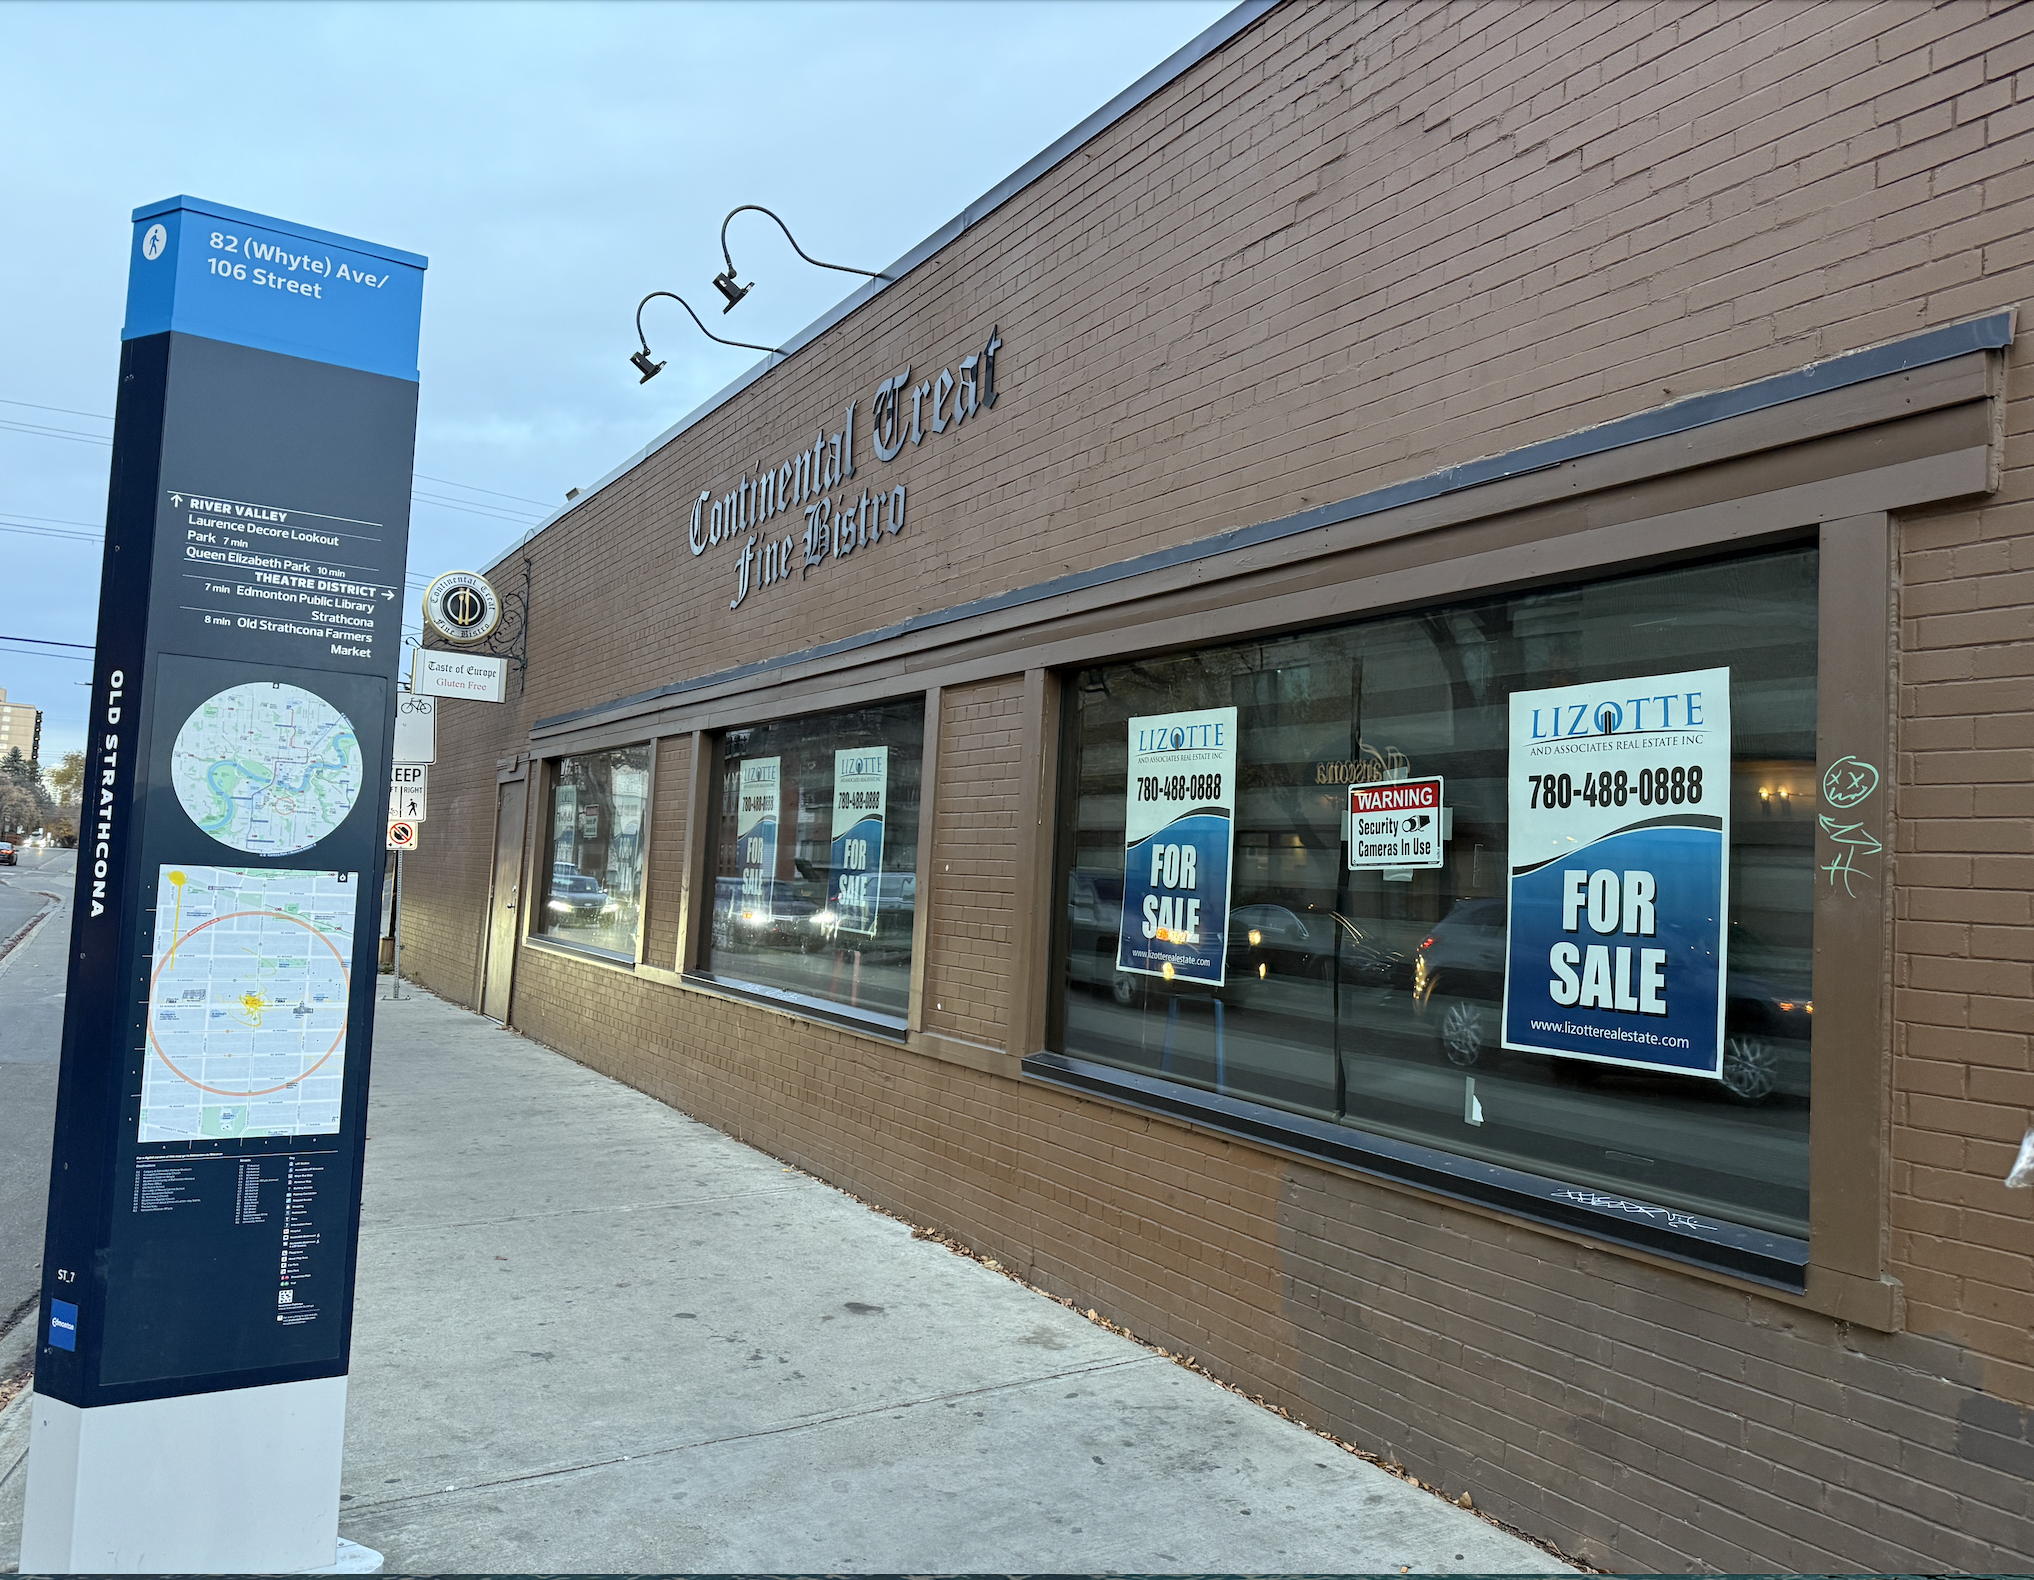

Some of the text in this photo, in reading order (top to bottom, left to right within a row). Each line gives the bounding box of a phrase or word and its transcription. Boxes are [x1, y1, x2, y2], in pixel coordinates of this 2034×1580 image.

[209, 231, 389, 289] 82 (Whyte) Ave/
[207, 257, 322, 298] 106 Street
[689, 324, 1003, 556] Continental Treat
[190, 498, 288, 523] RIVER VALLEY
[187, 530, 249, 548] Park 7 min
[188, 514, 339, 546] Laurence Decore Lookout
[802, 484, 906, 581] Bistro
[186, 547, 345, 578] Queen Elizabeth Park 10 min
[205, 583, 374, 614] 7 min Edmonton Public Library
[255, 572, 377, 597] THEATRE DISTRICT
[430, 577, 477, 603] Continental
[204, 615, 373, 643] 8 min Old Strathcona Farmers
[311, 611, 374, 627] Strathcona
[331, 644, 371, 658] Market
[428, 661, 496, 678] Taste of Europe
[436, 678, 486, 691] Gluten Free
[1530, 692, 1704, 739] LIZOTTE
[1139, 723, 1224, 751] LIZOTTE
[1530, 734, 1704, 756] AND ASSOCIATES REAL ESTATE INC
[842, 757, 881, 774] LIZOTTE
[90, 670, 124, 918] OLD STRATHCONA
[1137, 773, 1221, 801] 780-488-0888
[1358, 787, 1433, 810] WARNING
[1528, 766, 1703, 809] 780-488-0888
[1359, 817, 1398, 837] Security
[747, 837, 763, 864] FOR
[844, 839, 867, 870] FOR
[1359, 838, 1431, 857] Cameras In Use
[1150, 844, 1197, 890] FOR
[742, 868, 763, 896] SALE
[839, 874, 867, 907] SALE
[1561, 868, 1657, 937] FOR
[1142, 894, 1200, 944] SALE
[1132, 949, 1210, 966] www.lizotterealestate.com
[1549, 941, 1668, 1015] SALE
[1530, 1018, 1689, 1049] www.lizotterealestate.com
[52, 1317, 74, 1330] Edmonton
